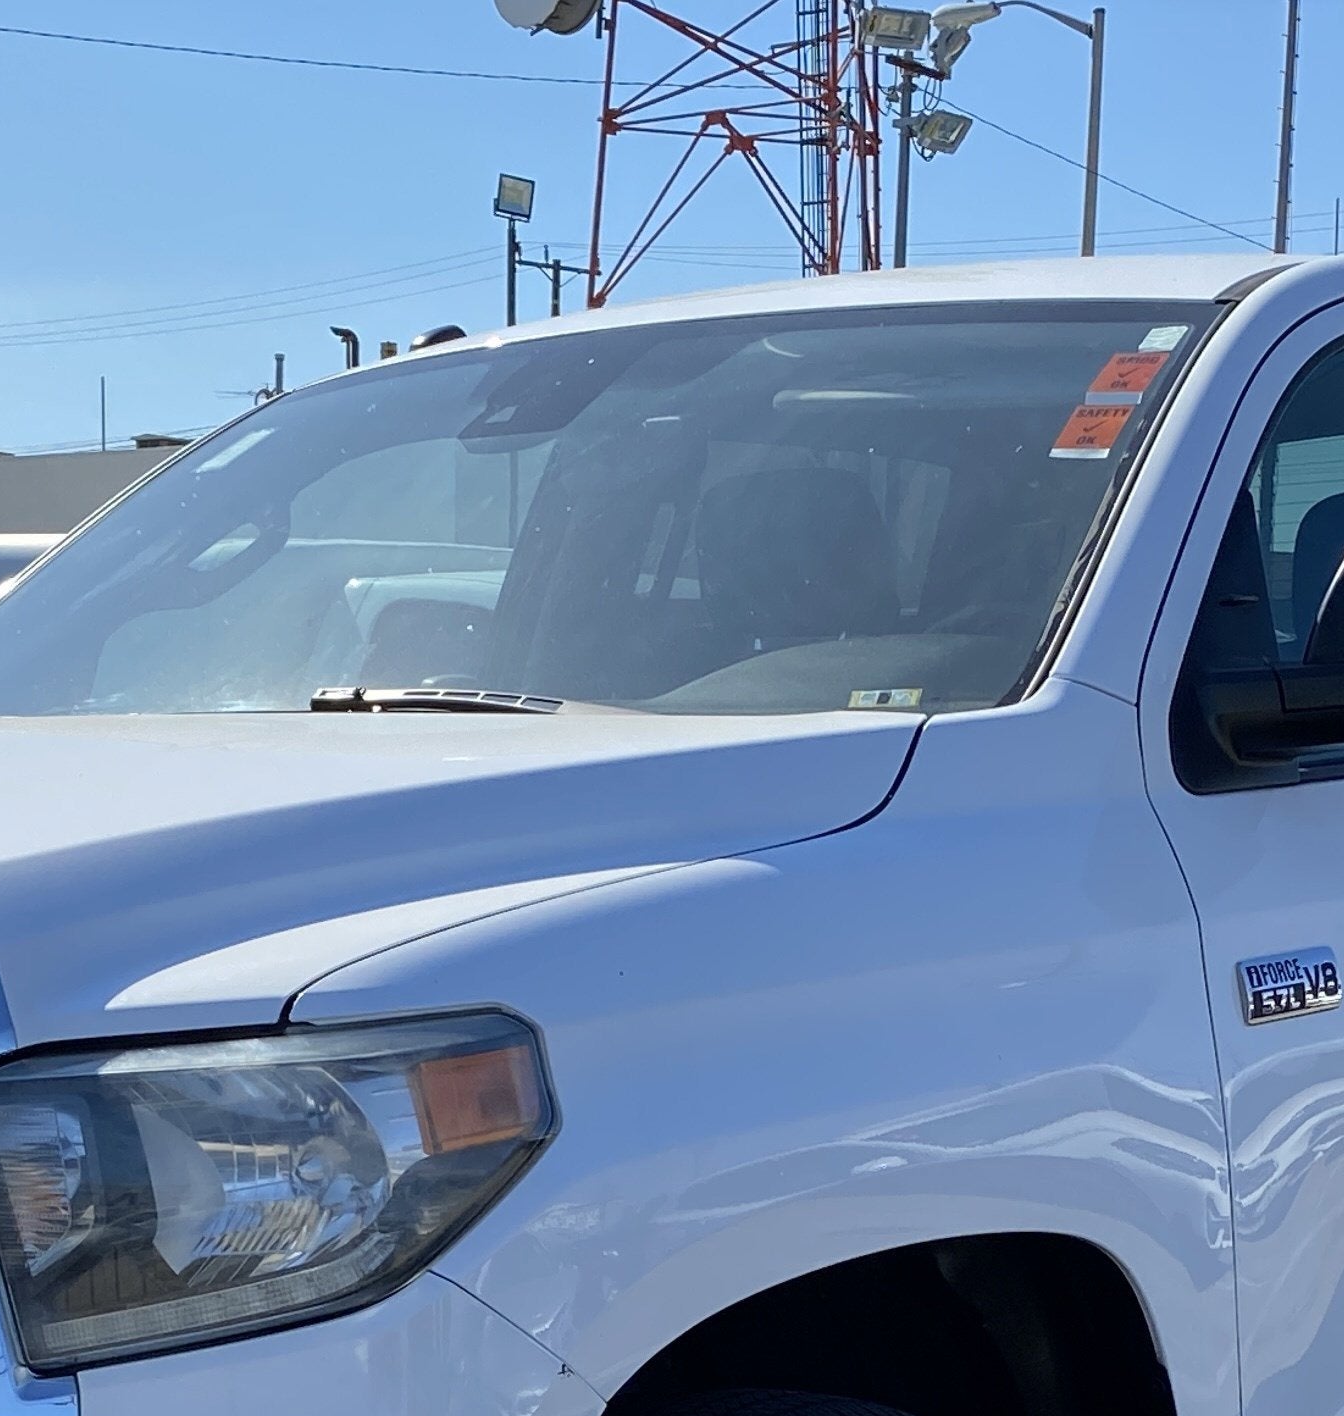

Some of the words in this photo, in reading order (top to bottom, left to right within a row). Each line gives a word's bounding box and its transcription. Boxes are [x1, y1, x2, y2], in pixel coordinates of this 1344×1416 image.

[1076, 408, 1130, 417] SAFETY
[1076, 436, 1096, 444] OK
[1304, 962, 1340, 999] V8
